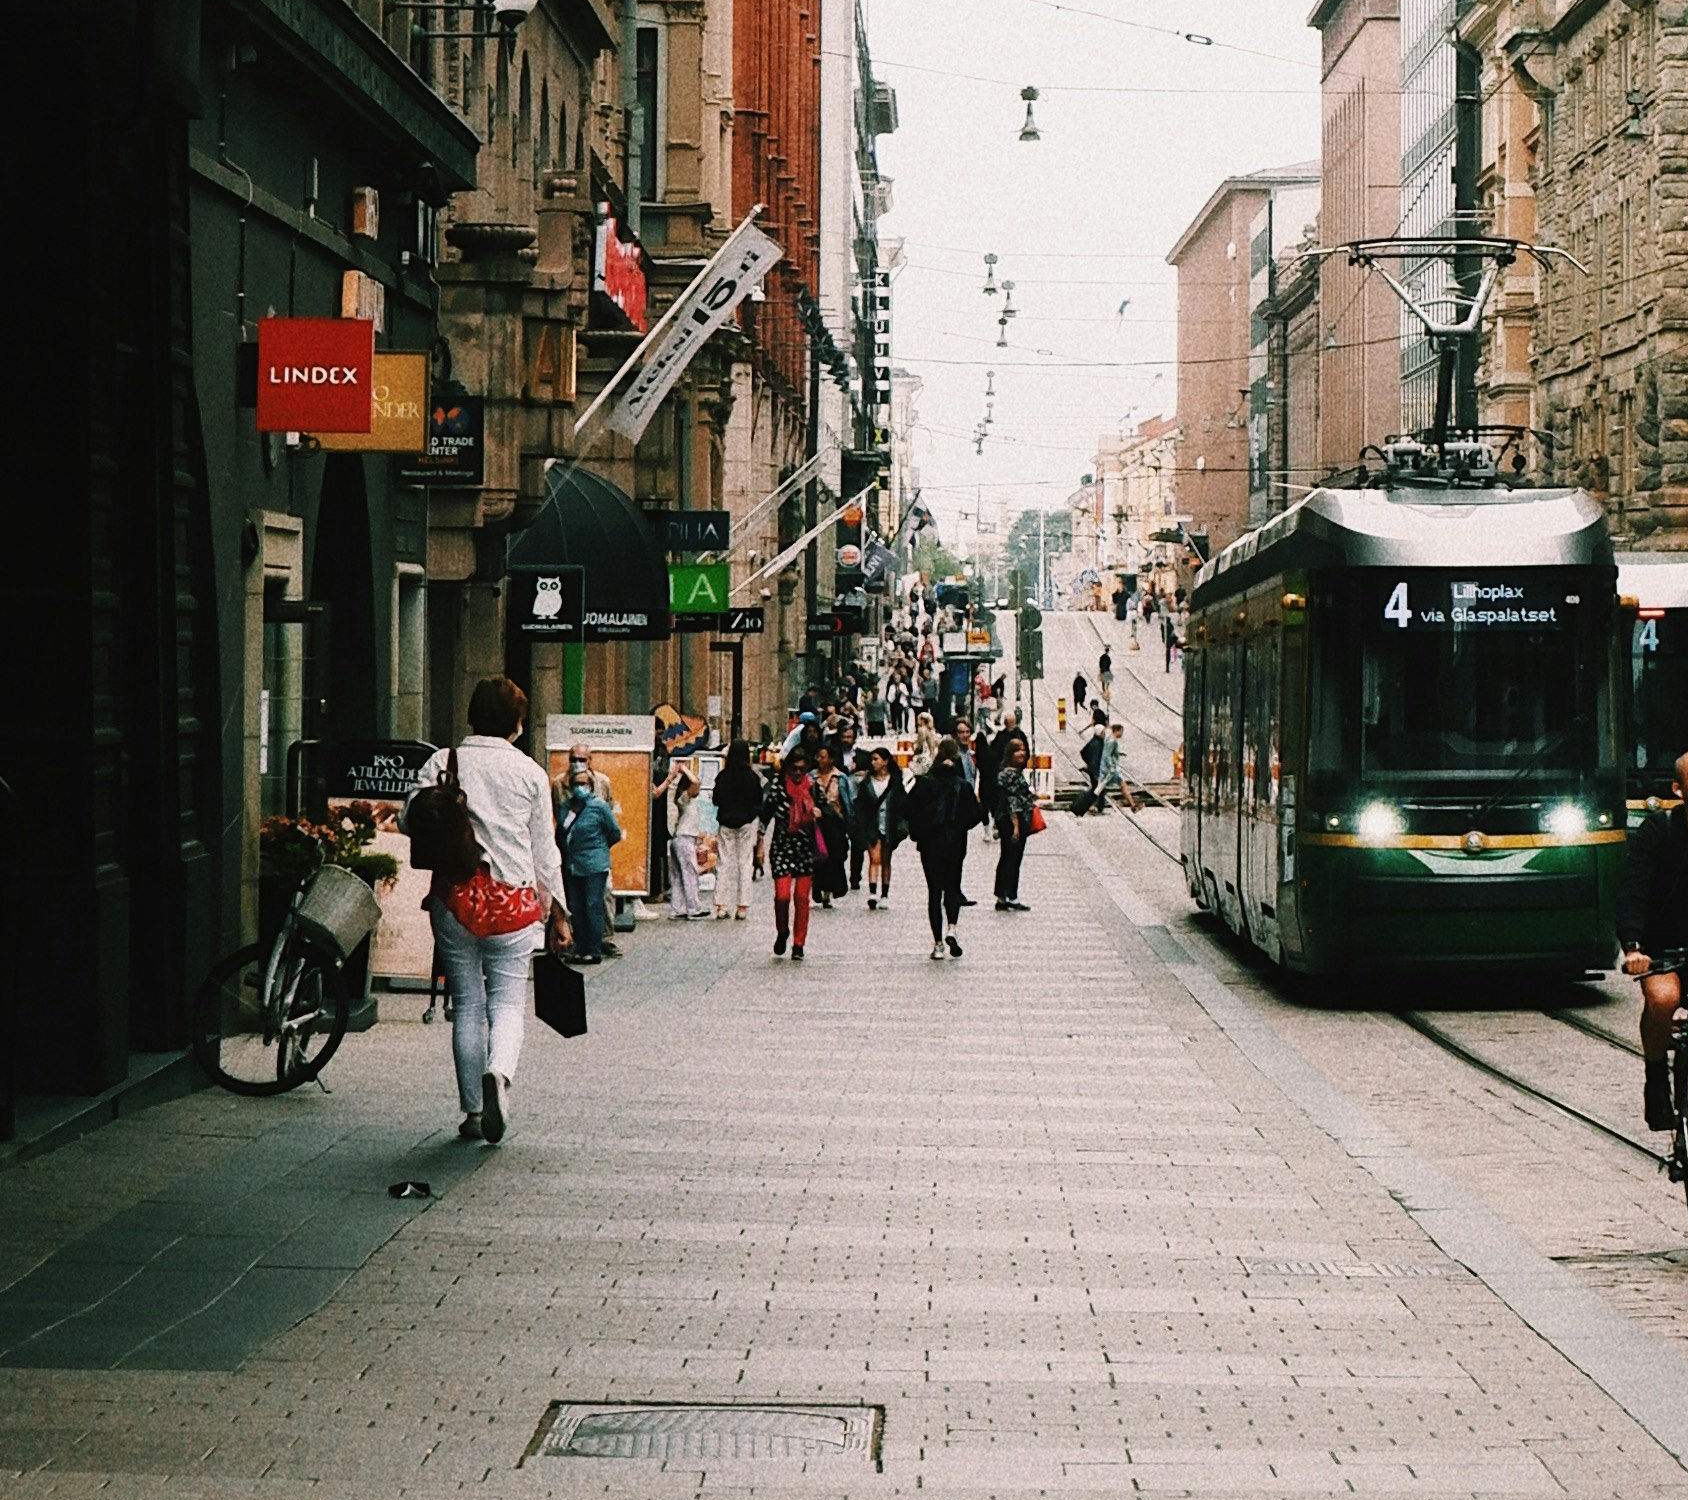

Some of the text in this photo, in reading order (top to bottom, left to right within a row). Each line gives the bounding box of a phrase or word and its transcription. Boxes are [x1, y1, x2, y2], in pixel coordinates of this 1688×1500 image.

[269, 366, 358, 385] LINDEX
[372, 402, 420, 419] NDER
[443, 437, 474, 446] TRADE
[1384, 582, 1524, 628] 4 Lillhoplax
[1421, 608, 1557, 625] via Glaspalatset
[1640, 619, 1659, 651] 4
